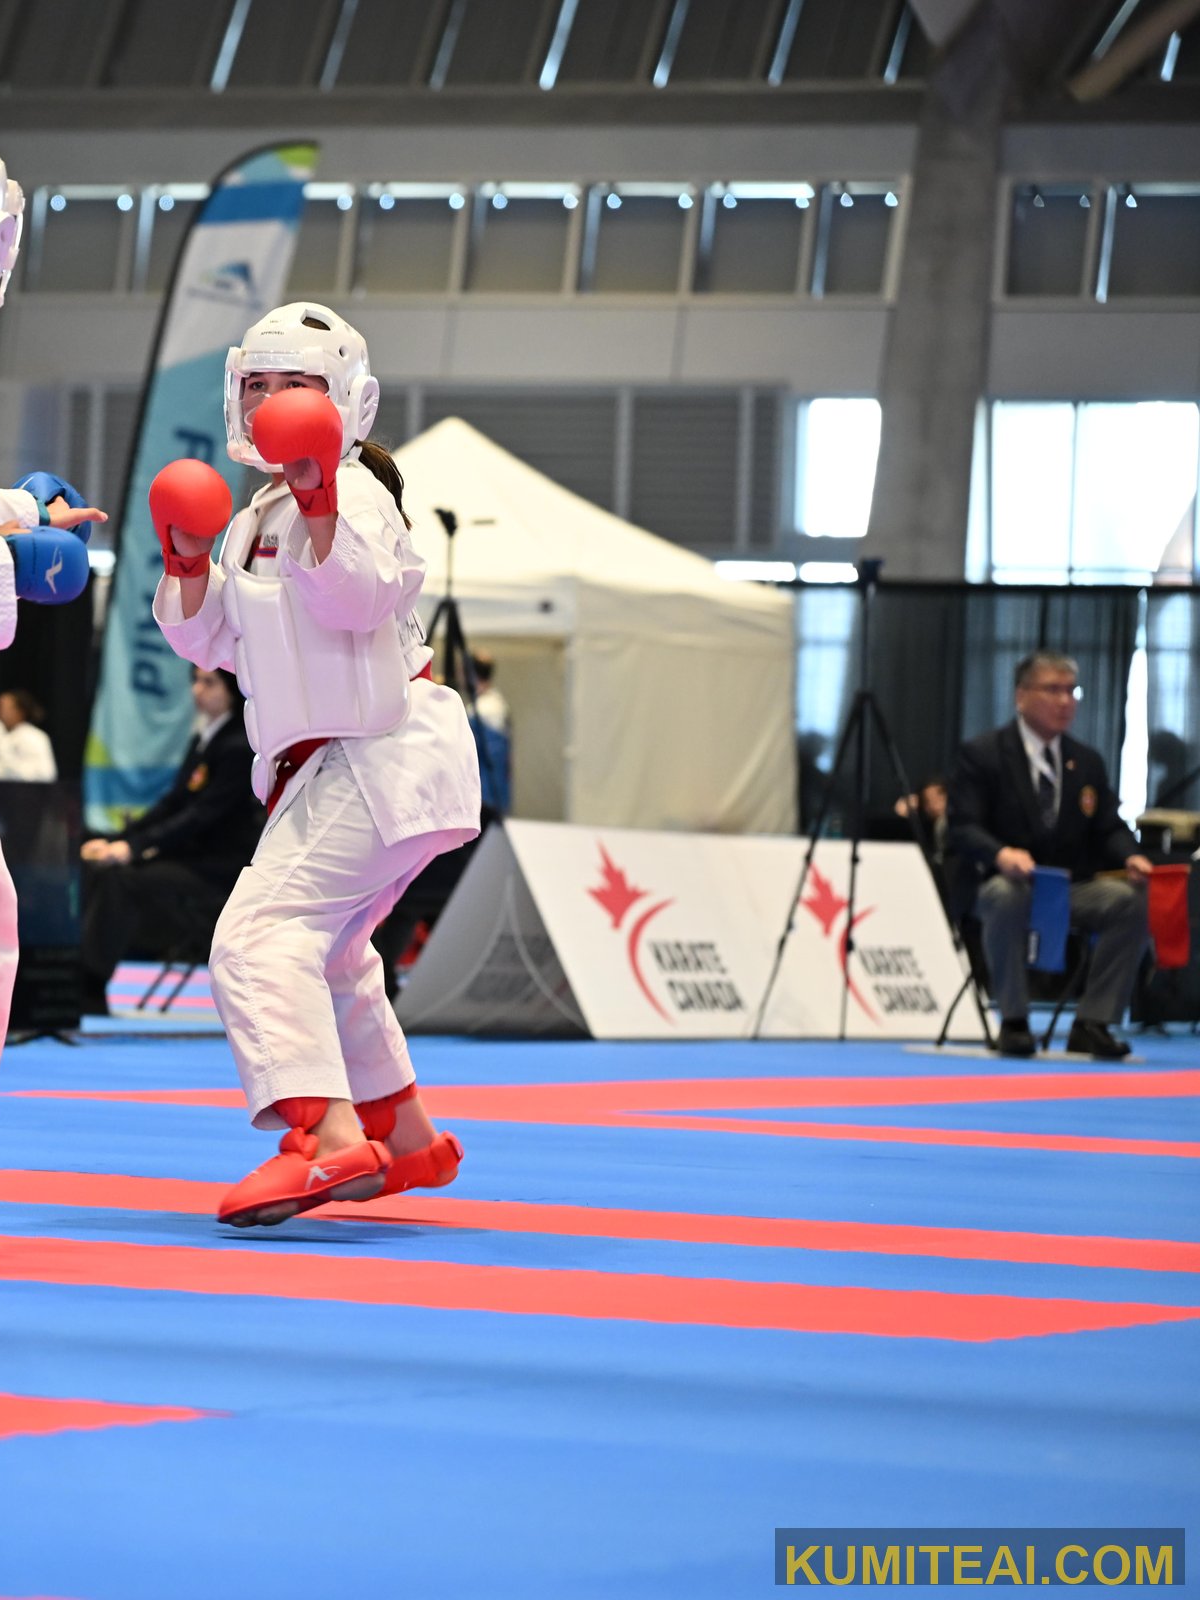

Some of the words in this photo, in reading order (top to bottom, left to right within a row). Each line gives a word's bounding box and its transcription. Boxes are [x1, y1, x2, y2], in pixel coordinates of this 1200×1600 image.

[649, 941, 726, 974] KARATE
[859, 948, 922, 978] KARATE
[668, 980, 745, 1011] CANADA
[874, 985, 939, 1013] CANADA
